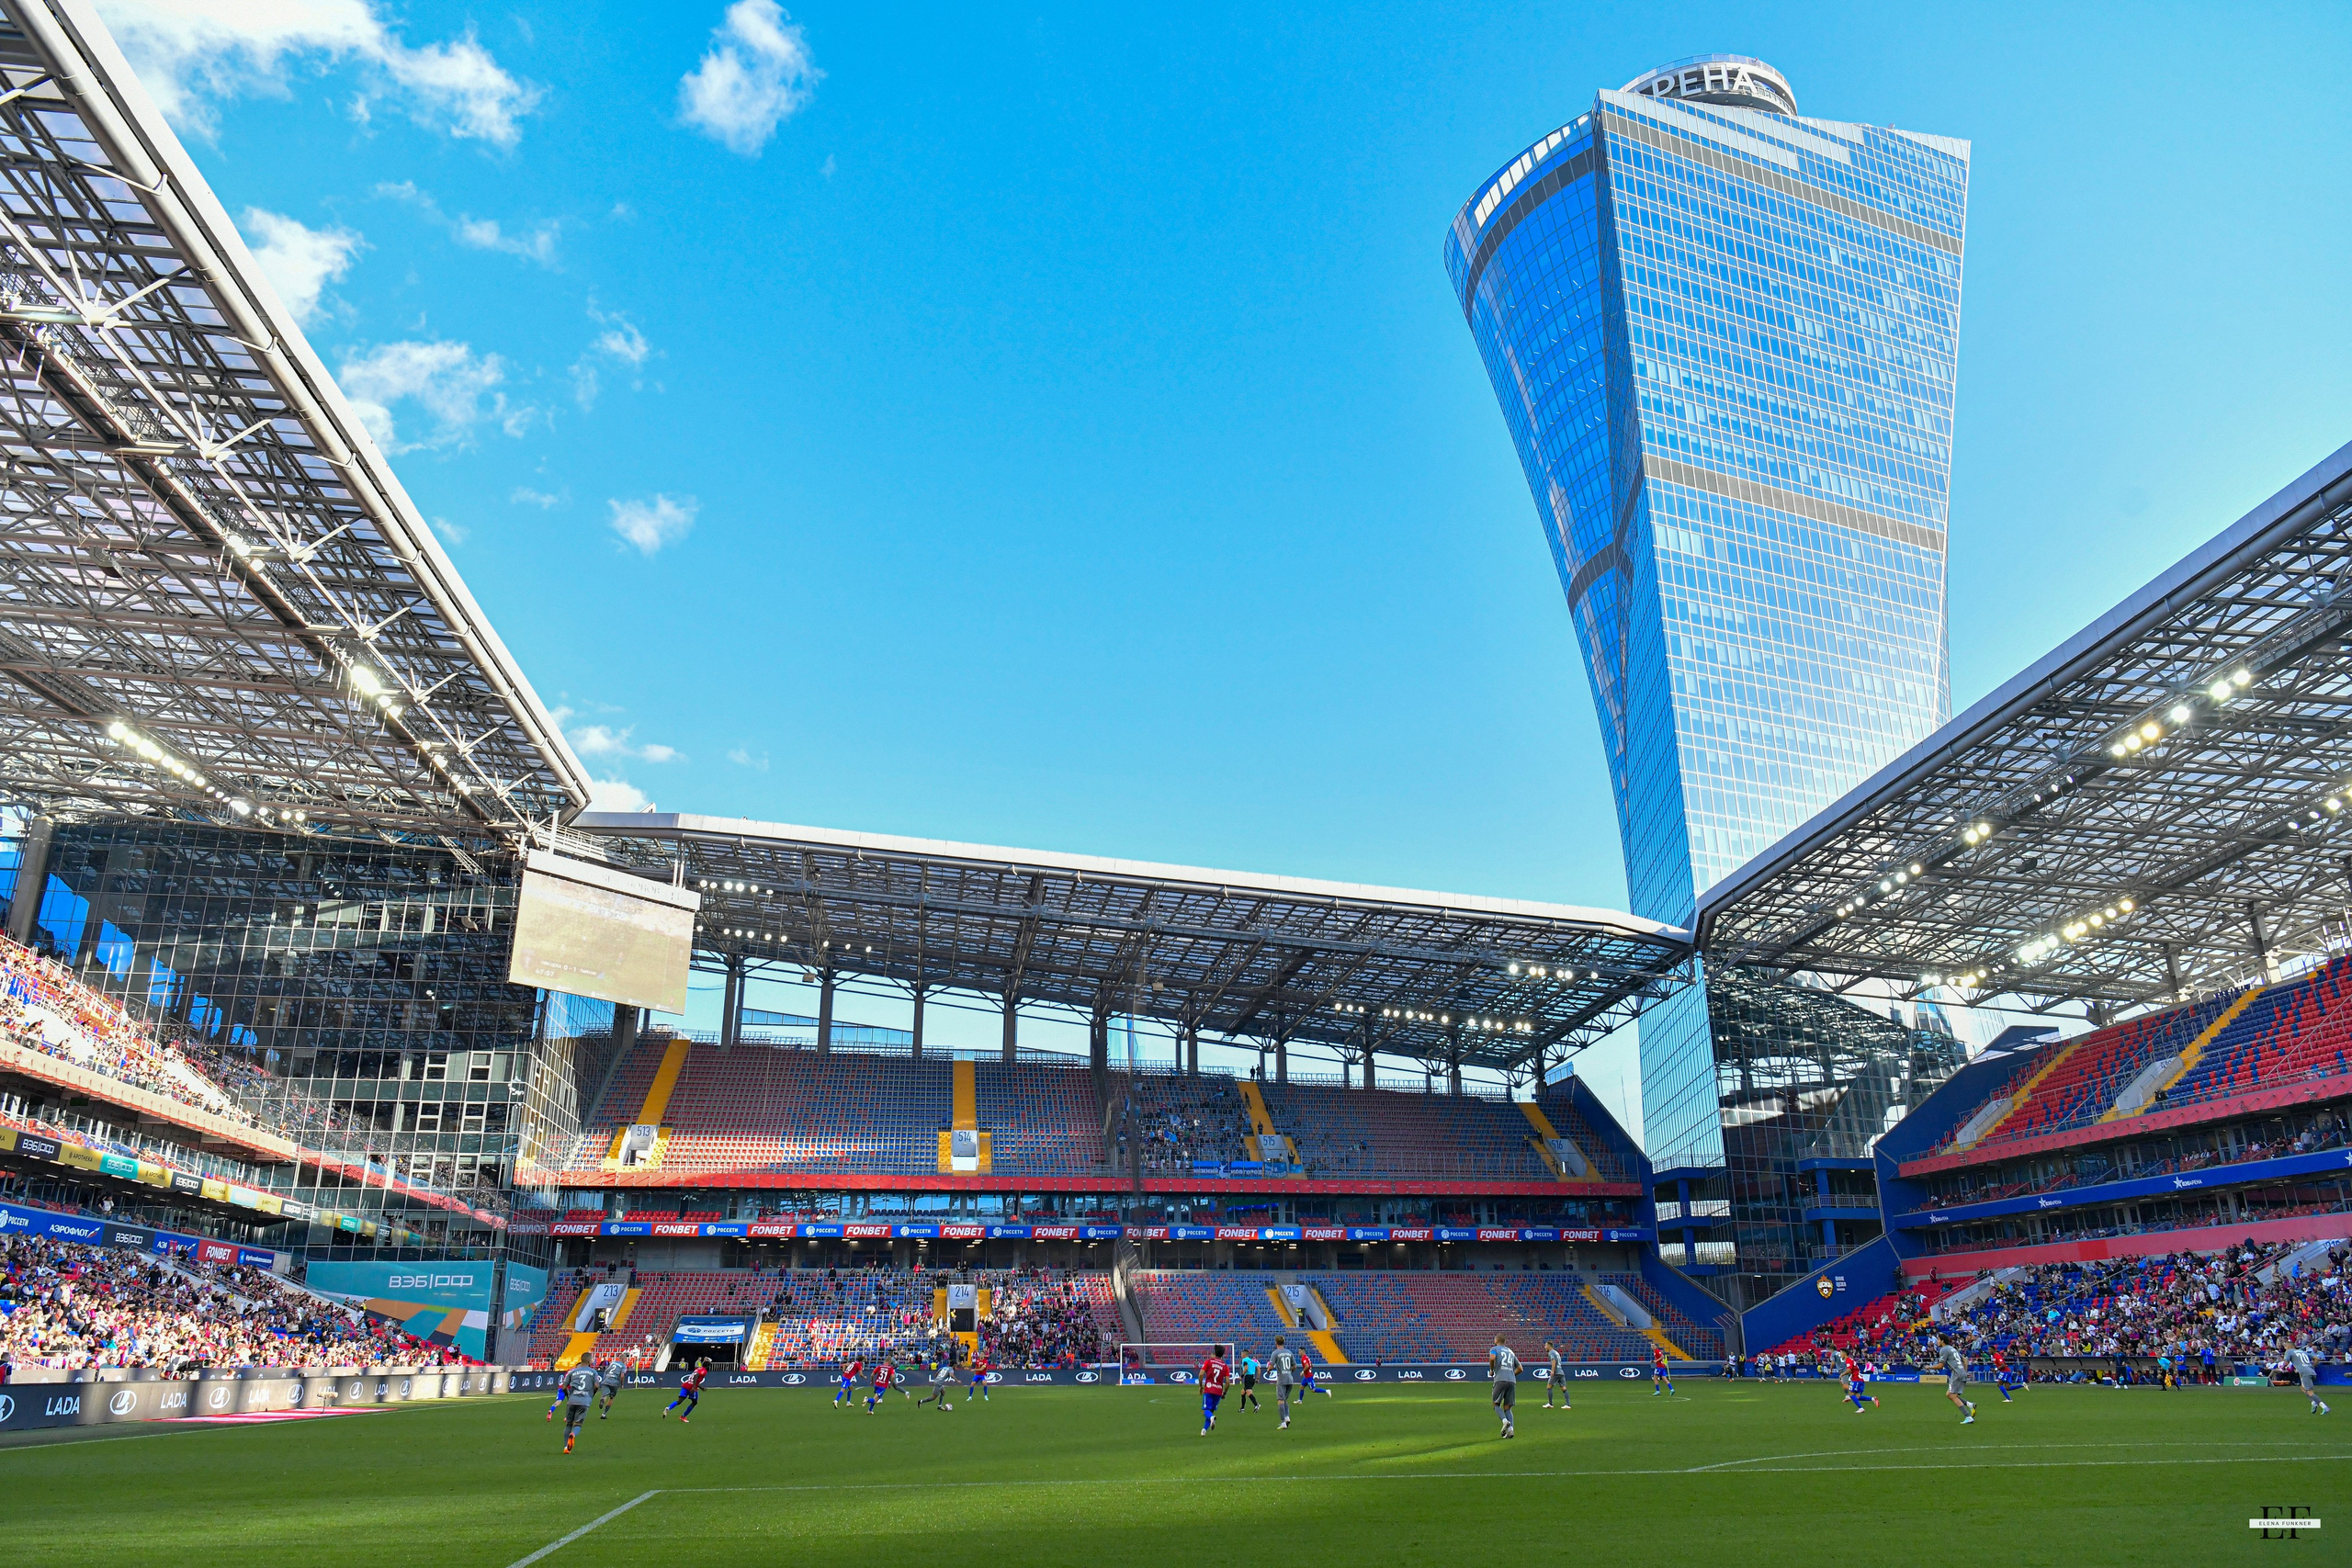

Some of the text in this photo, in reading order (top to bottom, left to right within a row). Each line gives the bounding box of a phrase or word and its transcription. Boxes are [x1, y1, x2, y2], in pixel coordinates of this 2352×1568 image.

[1643, 63, 1758, 97] РЕНА
[637, 1125, 650, 1137] 513
[958, 1131, 971, 1142] 514
[1551, 1139, 1564, 1150] 516
[7, 1215, 29, 1227] РОССЕТИ
[49, 1224, 90, 1237] АЭРОФЛОТ
[552, 1224, 597, 1234] FONBET
[655, 1225, 698, 1235] FONBET
[751, 1225, 793, 1235] FONBET
[846, 1226, 888, 1235] FONBET
[943, 1227, 984, 1236] FONBET
[1035, 1227, 1075, 1236] FONBET
[1126, 1228, 1165, 1237] FONBET
[1218, 1228, 1257, 1237] FONBET
[1306, 1229, 1343, 1238] FONBET
[1392, 1230, 1430, 1238] FONBET
[1479, 1230, 1516, 1239] FONBET
[1563, 1231, 1600, 1239] FONBET
[205, 1246, 232, 1260] FONBET
[603, 1285, 618, 1297] 213
[956, 1286, 969, 1297] 214
[1286, 1286, 1300, 1297] 215
[1281, 1356, 1291, 1370] 10
[1500, 1351, 1513, 1367] 24
[2296, 1352, 2310, 1364] 70
[609, 1364, 616, 1374] 2
[1575, 1370, 1600, 1378] LADA
[628, 1375, 655, 1384] LADA
[729, 1375, 757, 1384] LADA
[830, 1375, 857, 1383] LAA
[878, 1370, 888, 1382] 31
[1026, 1373, 1052, 1382] LADA
[1214, 1369, 1220, 1383] 7
[1313, 1371, 1332, 1380] ADA
[1397, 1371, 1423, 1379] LADA
[460, 1380, 472, 1391] LADA
[577, 1375, 586, 1391] 3
[249, 1385, 270, 1404] LADA
[374, 1383, 390, 1396] LADA
[45, 1396, 81, 1416] LADA
[160, 1392, 187, 1410] LADA
